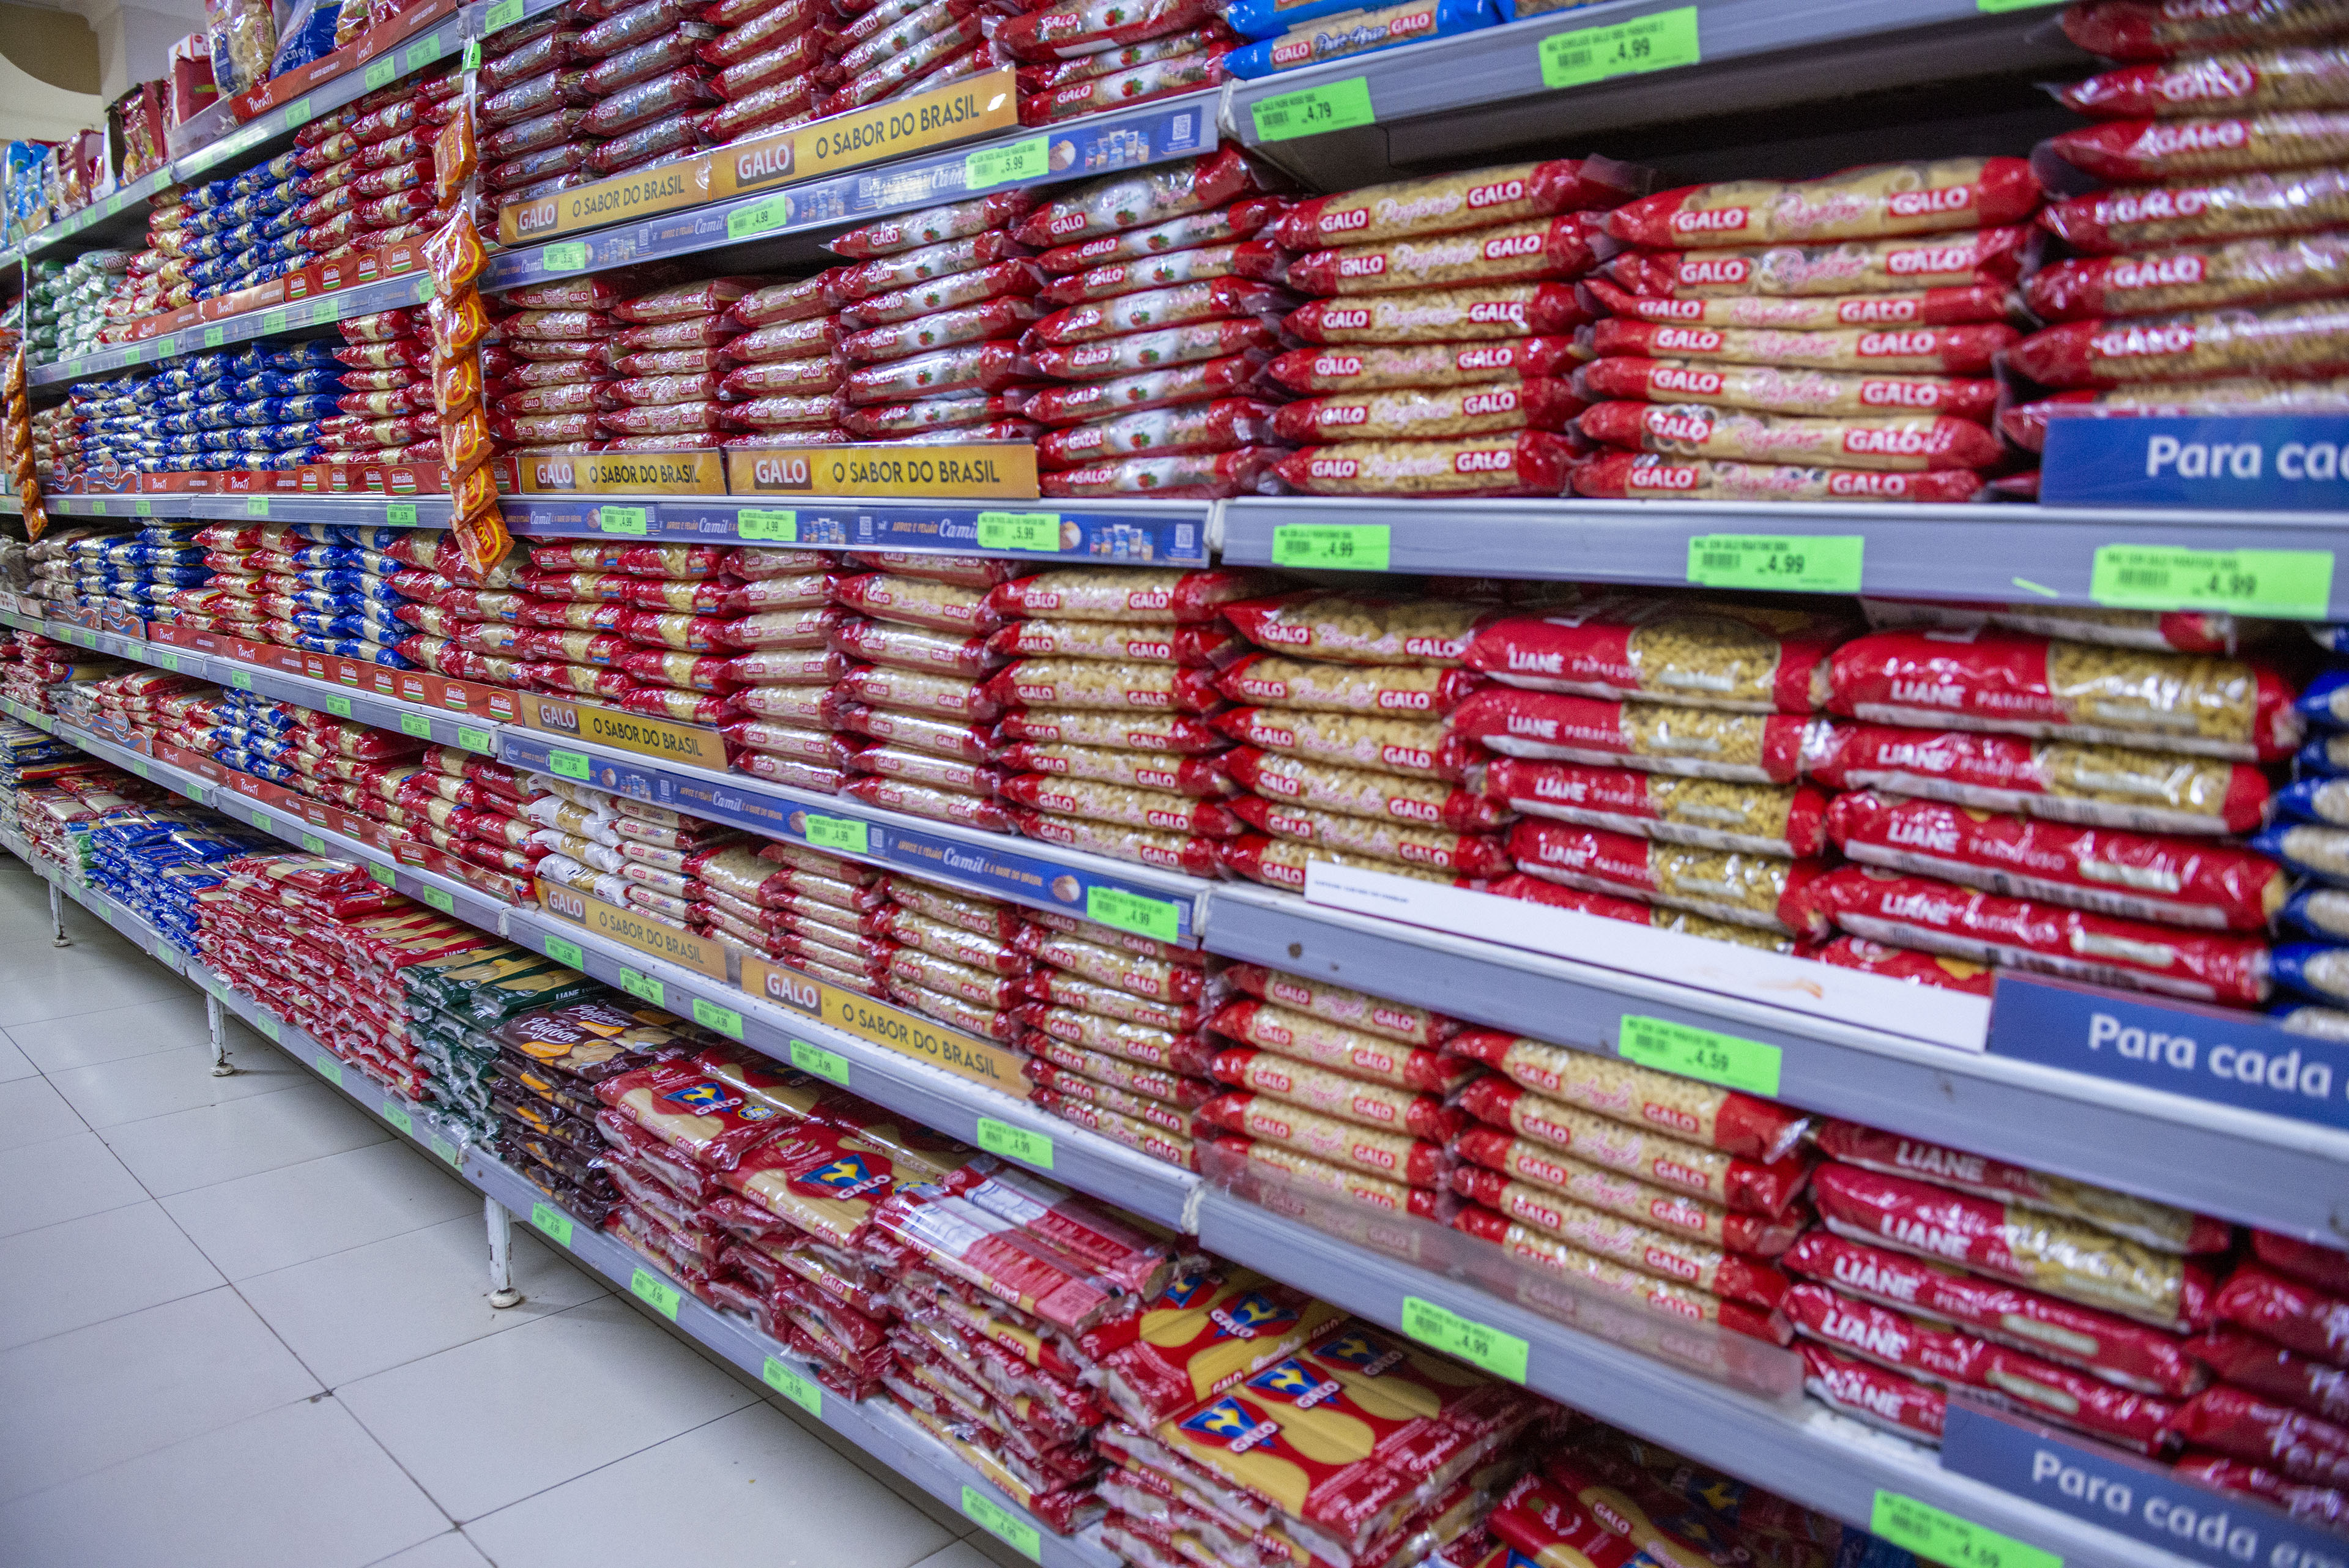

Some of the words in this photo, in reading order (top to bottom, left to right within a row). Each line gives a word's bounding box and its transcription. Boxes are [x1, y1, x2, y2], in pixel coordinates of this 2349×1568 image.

[853, 15, 879, 37] GALO
[1391, 13, 1430, 34] GALO
[1274, 43, 1309, 62] GALO
[247, 89, 273, 113] Parati
[1057, 85, 1092, 103] GALO
[599, 105, 617, 121] GALO
[816, 136, 828, 159] O
[833, 121, 885, 155] SABOR
[890, 112, 915, 140] DO
[921, 94, 979, 132] BRASIL
[2155, 123, 2245, 151] GALO
[738, 144, 790, 180] GALO
[573, 199, 581, 218] O
[584, 188, 619, 215] SABOR
[623, 184, 640, 206] DO
[644, 174, 685, 201] BRASIL
[1469, 181, 1523, 206] GALO
[1892, 188, 1969, 213] GALO
[2116, 191, 2201, 222] GALO
[519, 204, 555, 230] GALO
[695, 217, 725, 235] Camil
[1051, 215, 1085, 234] GALO
[1322, 210, 1366, 230] GALO
[1676, 210, 1743, 232] GALO
[1082, 238, 1117, 256] GALO
[1486, 235, 1541, 257] GALO
[359, 259, 376, 271] Amália
[392, 251, 410, 263] Amália
[1341, 256, 1382, 276] GALO
[324, 269, 340, 280] Amália
[1680, 262, 1743, 283] GALO
[2114, 256, 2200, 288] GALO
[291, 278, 305, 289] Amália
[1323, 310, 1367, 328] GALO
[1471, 303, 1524, 322] GALO
[1657, 330, 1719, 349] GALO
[1860, 333, 1935, 355] GALO
[746, 373, 763, 383] GALO
[802, 368, 821, 379] GALO
[525, 398, 539, 408] GALO
[1465, 392, 1515, 414] GALO
[1864, 384, 1939, 406] GALO
[562, 424, 579, 434] GALO
[629, 417, 646, 428] GALO
[1457, 451, 1510, 470] GALO
[2146, 436, 2262, 478] Para
[302, 473, 317, 483] Amália
[392, 473, 414, 484] Amália
[536, 463, 572, 484] GALO
[590, 466, 598, 483] O
[601, 466, 636, 483] SABOR
[641, 466, 658, 483] DO
[661, 465, 700, 483] BRASIL
[755, 459, 807, 484] GALO
[833, 462, 845, 483] O
[850, 461, 902, 483] SABOR
[908, 461, 933, 482] DO
[940, 459, 1000, 483] BRASIL
[1312, 461, 1356, 477] GALO
[1632, 469, 1693, 488] GALO
[153, 478, 167, 489] Parati
[231, 477, 250, 489] Parati
[700, 518, 728, 533] Camil
[868, 591, 890, 604] GALO
[1024, 593, 1059, 608] GALO
[1130, 593, 1168, 609] GALO
[944, 606, 970, 619] GALO
[159, 628, 174, 641] Parati
[237, 644, 256, 659] Parati
[1407, 639, 1457, 657] GALO
[308, 660, 323, 671] Amália
[1509, 650, 1562, 672] LIANE
[341, 666, 356, 677] Amália
[376, 674, 392, 686] Amália
[404, 680, 423, 693] Amália
[446, 688, 466, 701] Amália
[1891, 678, 1964, 706] LIANE
[490, 697, 511, 711] Amália
[1379, 691, 1430, 710] GALO
[541, 705, 576, 728] GALO
[1508, 716, 1559, 737] LIANE
[593, 718, 602, 733] O
[605, 719, 640, 742] SABOR
[644, 729, 660, 745] DO
[662, 734, 703, 757] BRASIL
[749, 732, 765, 742] GALO
[1878, 744, 1950, 772] LIANE
[1535, 777, 1587, 802] LIANE
[713, 791, 743, 813] Camil
[625, 823, 637, 833] GALO
[1887, 820, 1959, 851] LIANE
[401, 847, 421, 859] Amália
[943, 847, 984, 873] Camil
[549, 891, 582, 918] GALO
[1881, 894, 1951, 926] LIANE
[599, 912, 607, 927] O
[610, 914, 643, 945] SABOR
[646, 926, 663, 948] DO
[666, 934, 704, 964] BRASIL
[556, 989, 579, 1001] LIANE
[766, 973, 818, 1009] GALO
[568, 1003, 631, 1027] Petybon
[521, 1017, 582, 1042] Petybon
[1052, 1022, 1080, 1039] GALO
[842, 1004, 854, 1022] O
[859, 1010, 908, 1045] SABOR
[914, 1030, 938, 1054] DO
[943, 1042, 1000, 1079] BRASIL
[1128, 1042, 1159, 1061] GALO
[2090, 1014, 2196, 1069] Para
[2208, 1043, 2332, 1098] cada
[620, 1102, 636, 1118] GALO
[695, 1097, 743, 1116] GALO
[675, 1137, 694, 1154] GALO
[1354, 1146, 1393, 1167] GALO
[1894, 1141, 1987, 1182] LIANE
[1655, 1163, 1705, 1186] GALO
[837, 1175, 891, 1201] GALO
[1881, 1214, 1971, 1260] LIANE
[1835, 1254, 1918, 1302] LIANE
[1211, 1307, 1255, 1339] GALO
[1822, 1309, 1908, 1361] LIANE
[1296, 1380, 1341, 1408] GALO
[1230, 1421, 1278, 1454] GALO
[2031, 1450, 2132, 1513] Para
[2142, 1496, 2258, 1562] cada
[1593, 1501, 1630, 1534] GALO
